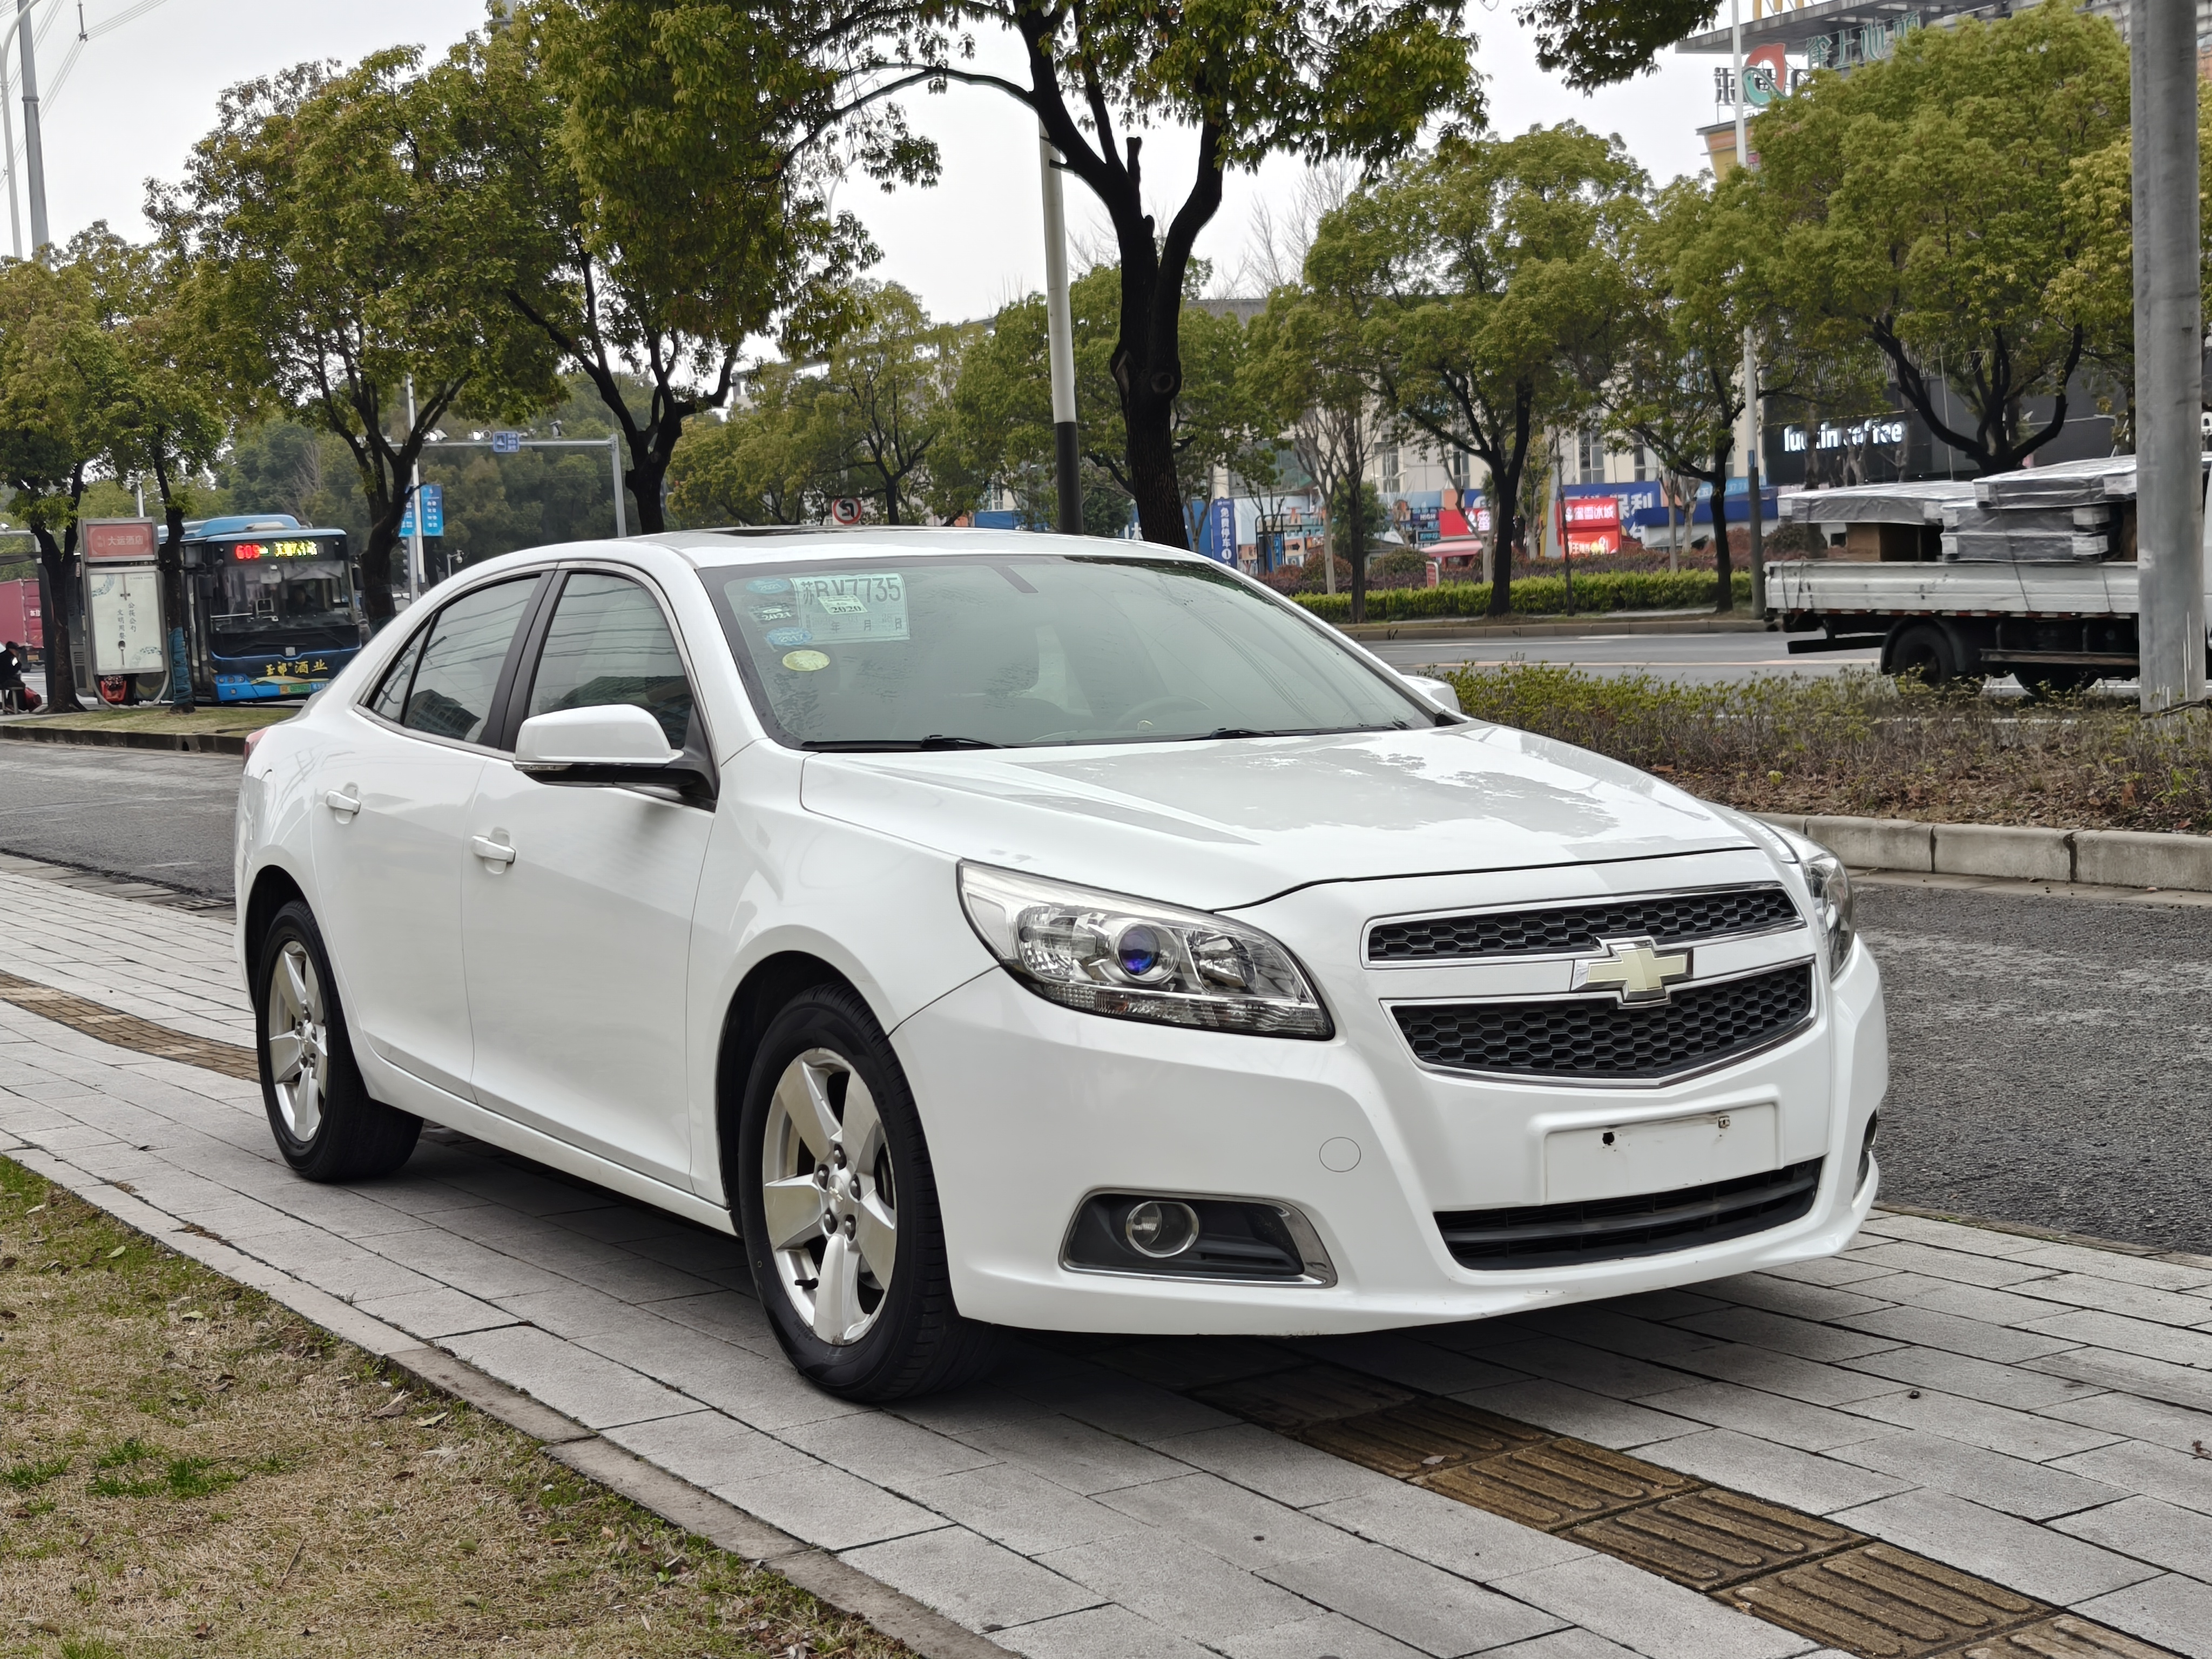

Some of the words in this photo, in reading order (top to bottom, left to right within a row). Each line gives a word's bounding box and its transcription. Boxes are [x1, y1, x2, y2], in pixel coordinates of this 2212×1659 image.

[117, 609, 126, 639] 文明用餐
[128, 602, 137, 632] 公筷公勺
